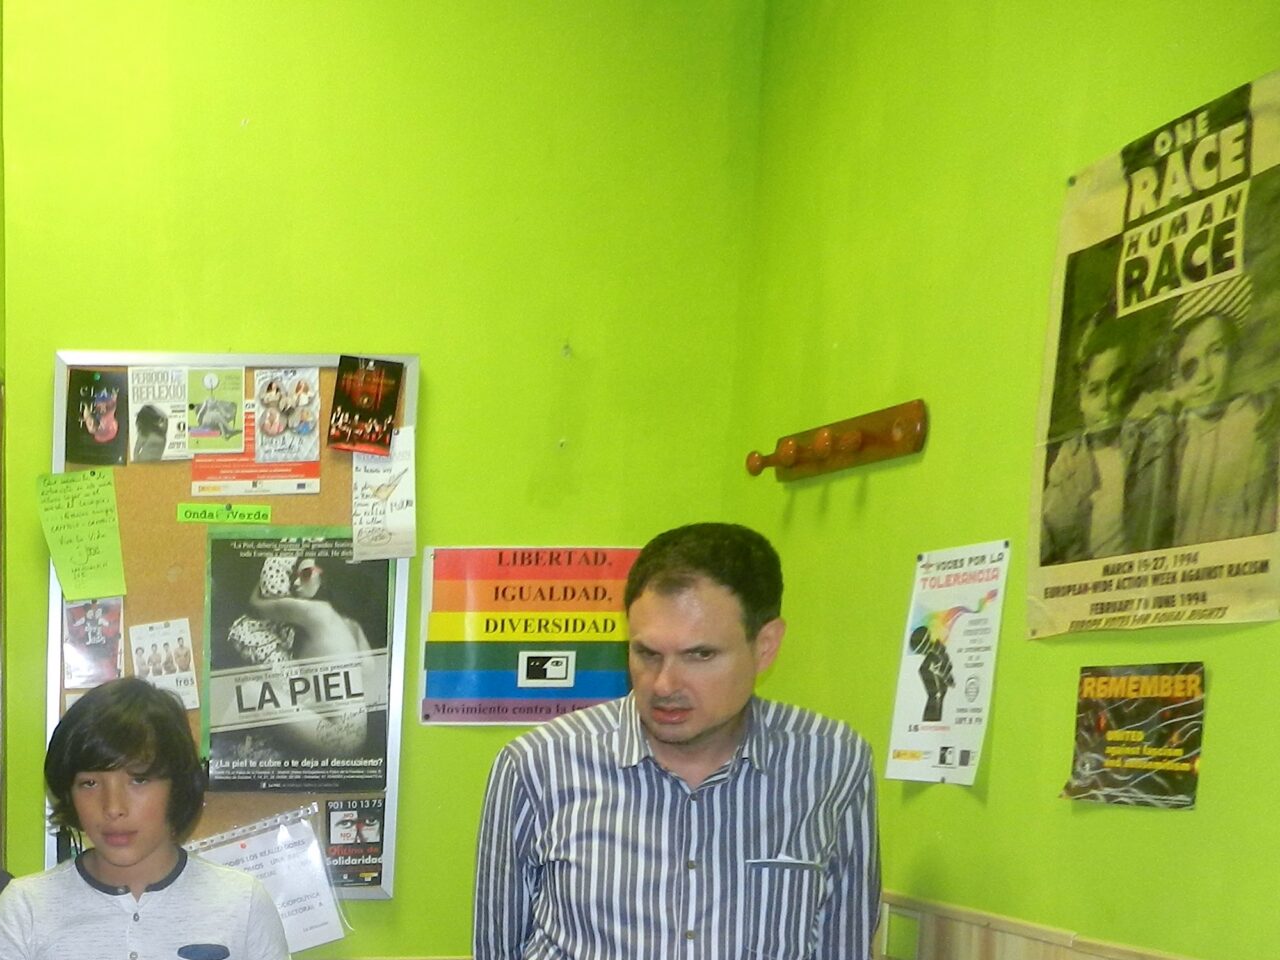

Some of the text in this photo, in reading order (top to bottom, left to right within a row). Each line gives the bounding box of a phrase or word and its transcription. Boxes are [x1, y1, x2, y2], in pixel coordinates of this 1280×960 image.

[1154, 110, 1209, 157] ONE
[1127, 119, 1247, 223] RACE
[1125, 188, 1243, 257] HUMAN
[1123, 217, 1237, 309] RACE
[184, 510, 269, 520] Onda Verde
[1044, 559, 1270, 599] EUROPEAN-WIDE ACTION WEEK AGAINST RACISM
[1102, 562, 1134, 577] MARCH
[1089, 599, 1134, 616] FEBRUARY
[1152, 594, 1176, 610] JUNE
[484, 617, 616, 633] DIVERSIDAD
[235, 681, 281, 713] LA
[289, 670, 364, 706] PIEL
[1082, 674, 1201, 698] REMEMBER
[433, 703, 508, 716] Movimiento
[512, 705, 552, 715] contra
[555, 703, 567, 714] la
[232, 759, 247, 769] piel
[249, 759, 257, 768] te
[259, 758, 281, 768] cubre
[291, 759, 299, 768] te
[301, 758, 319, 769] deja
[321, 757, 329, 767] al
[328, 800, 383, 809] 901 10 13 75
